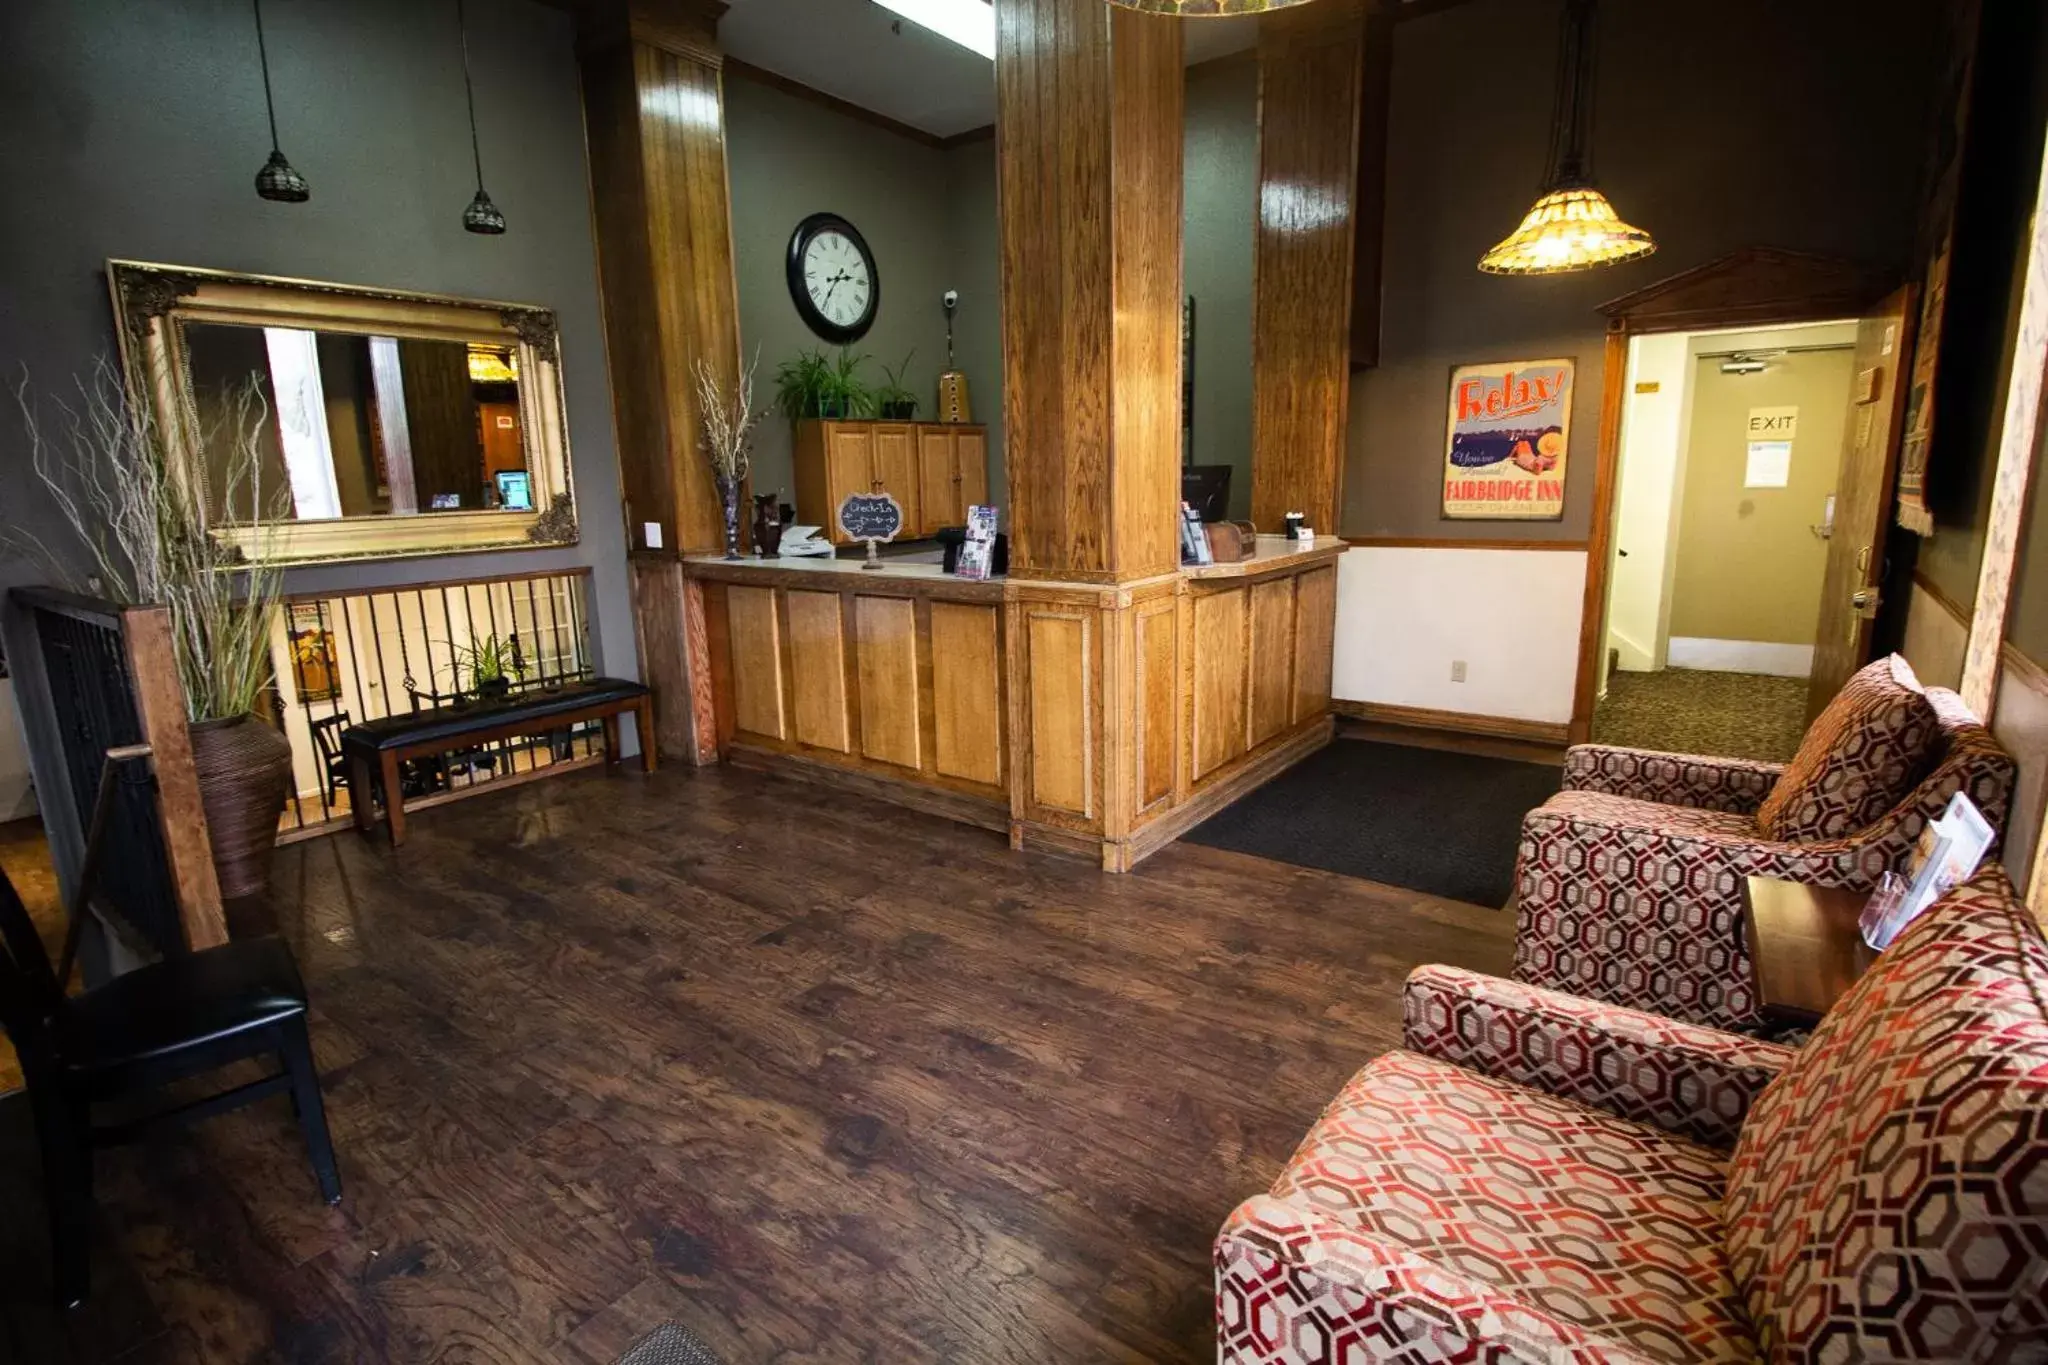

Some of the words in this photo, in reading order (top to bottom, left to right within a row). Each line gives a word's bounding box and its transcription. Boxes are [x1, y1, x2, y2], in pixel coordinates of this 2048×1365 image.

[1456, 371, 1565, 422] Relax!
[1750, 415, 1795, 431] EXIT
[1446, 480, 1533, 501] FAIRBRIDGE
[1537, 479, 1563, 500] INN
